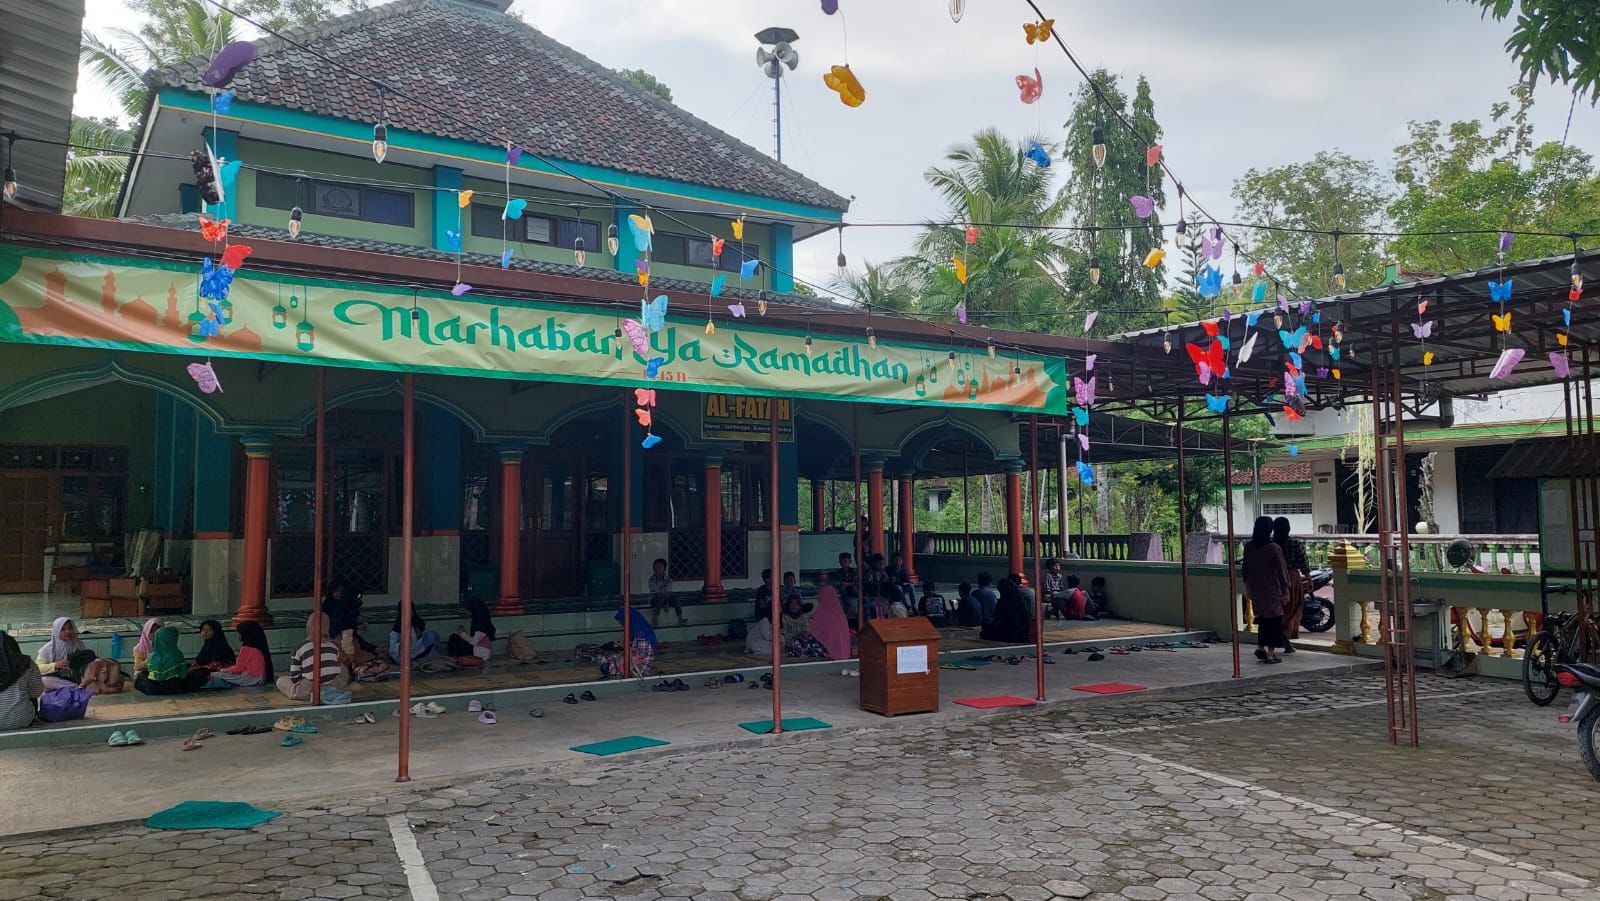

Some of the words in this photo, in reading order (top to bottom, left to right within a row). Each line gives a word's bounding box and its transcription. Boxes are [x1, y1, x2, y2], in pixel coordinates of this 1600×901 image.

[333, 299, 623, 361] Marhaban
[632, 326, 709, 367] Ya
[712, 333, 910, 384] Ramadhan
[642, 368, 673, 382] 145
